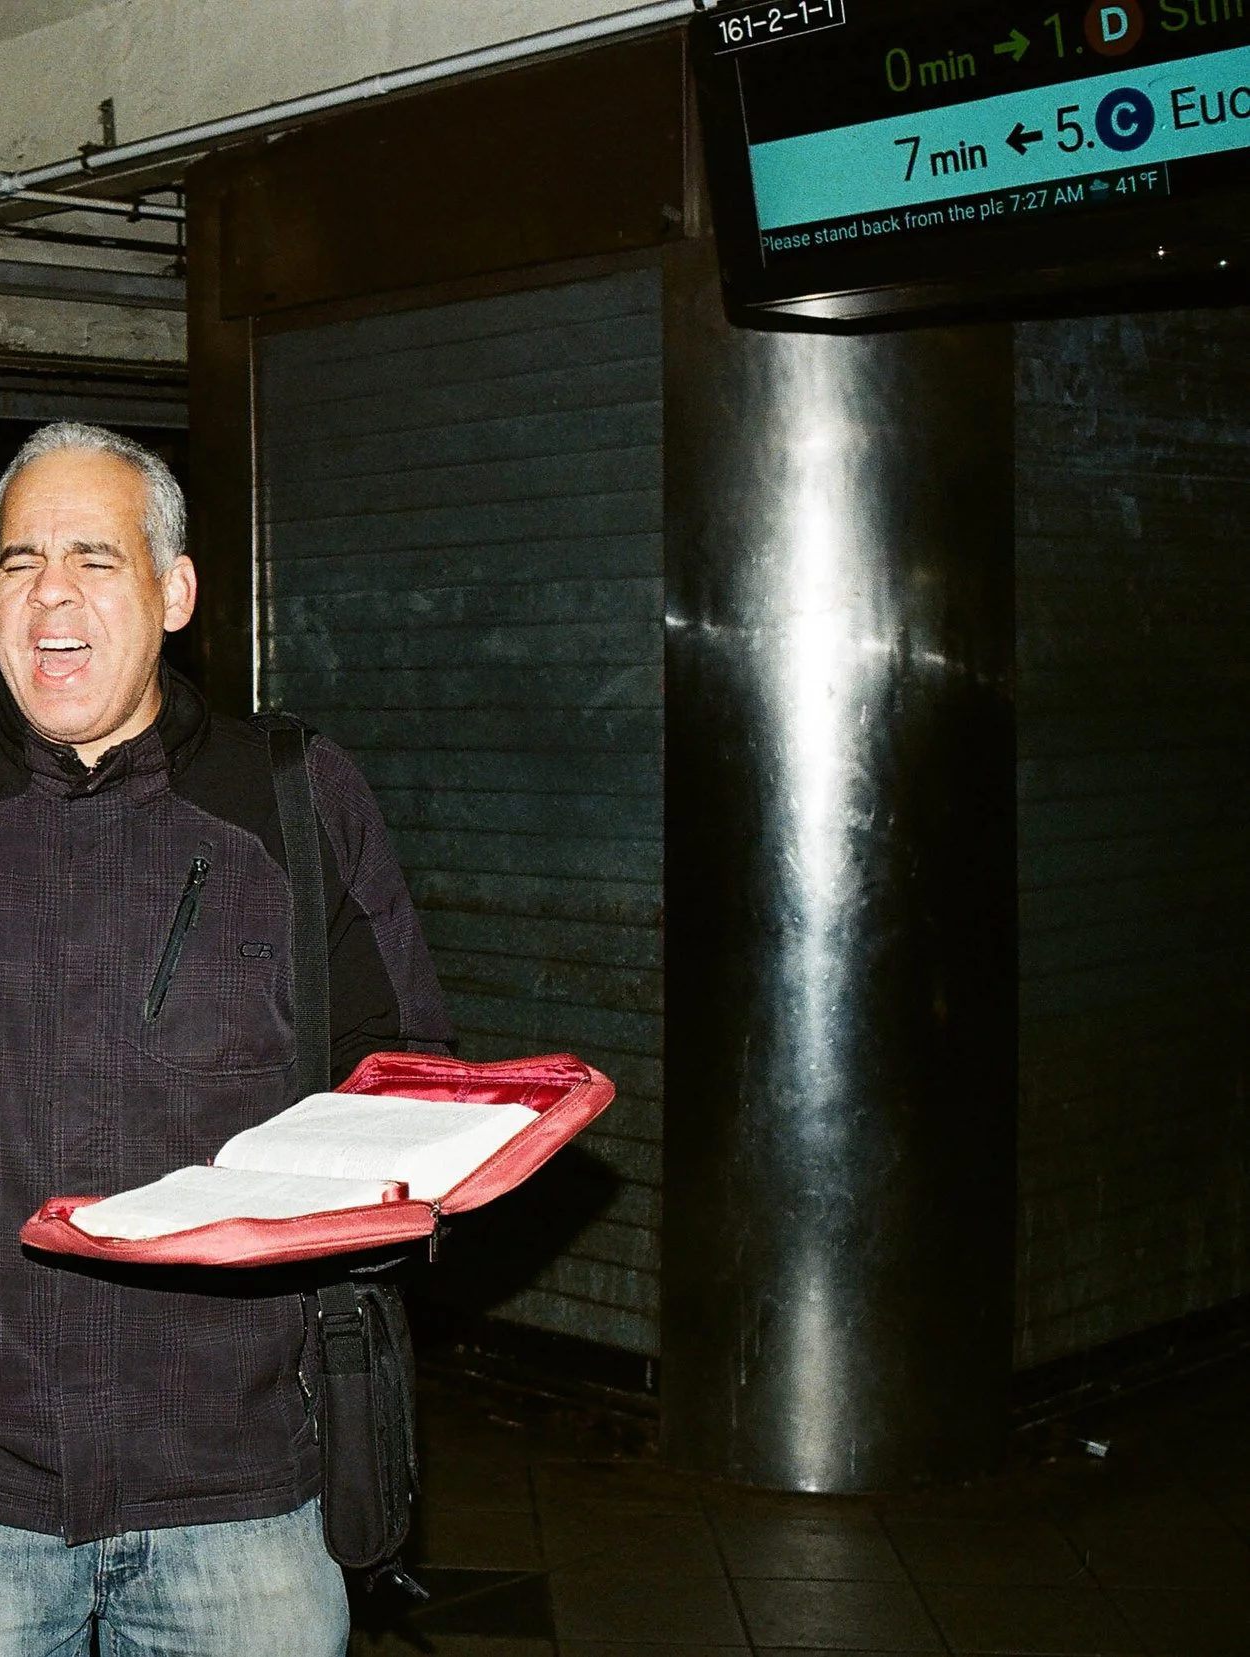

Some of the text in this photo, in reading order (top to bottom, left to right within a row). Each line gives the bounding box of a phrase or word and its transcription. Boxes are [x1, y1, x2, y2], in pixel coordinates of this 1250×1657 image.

[718, 0, 833, 44] 161-2-1-1
[885, 47, 911, 93] 0
[918, 49, 977, 87] min
[1100, 5, 1129, 43] D
[894, 136, 920, 180] 7
[930, 140, 987, 176] min
[1056, 105, 1095, 153] 5.
[1111, 102, 1139, 138] C
[1009, 190, 1047, 213] 7:27
[1054, 184, 1084, 206] AM
[814, 221, 859, 244] stand
[862, 217, 901, 236] back
[905, 210, 944, 229] from
[948, 203, 975, 222] the
